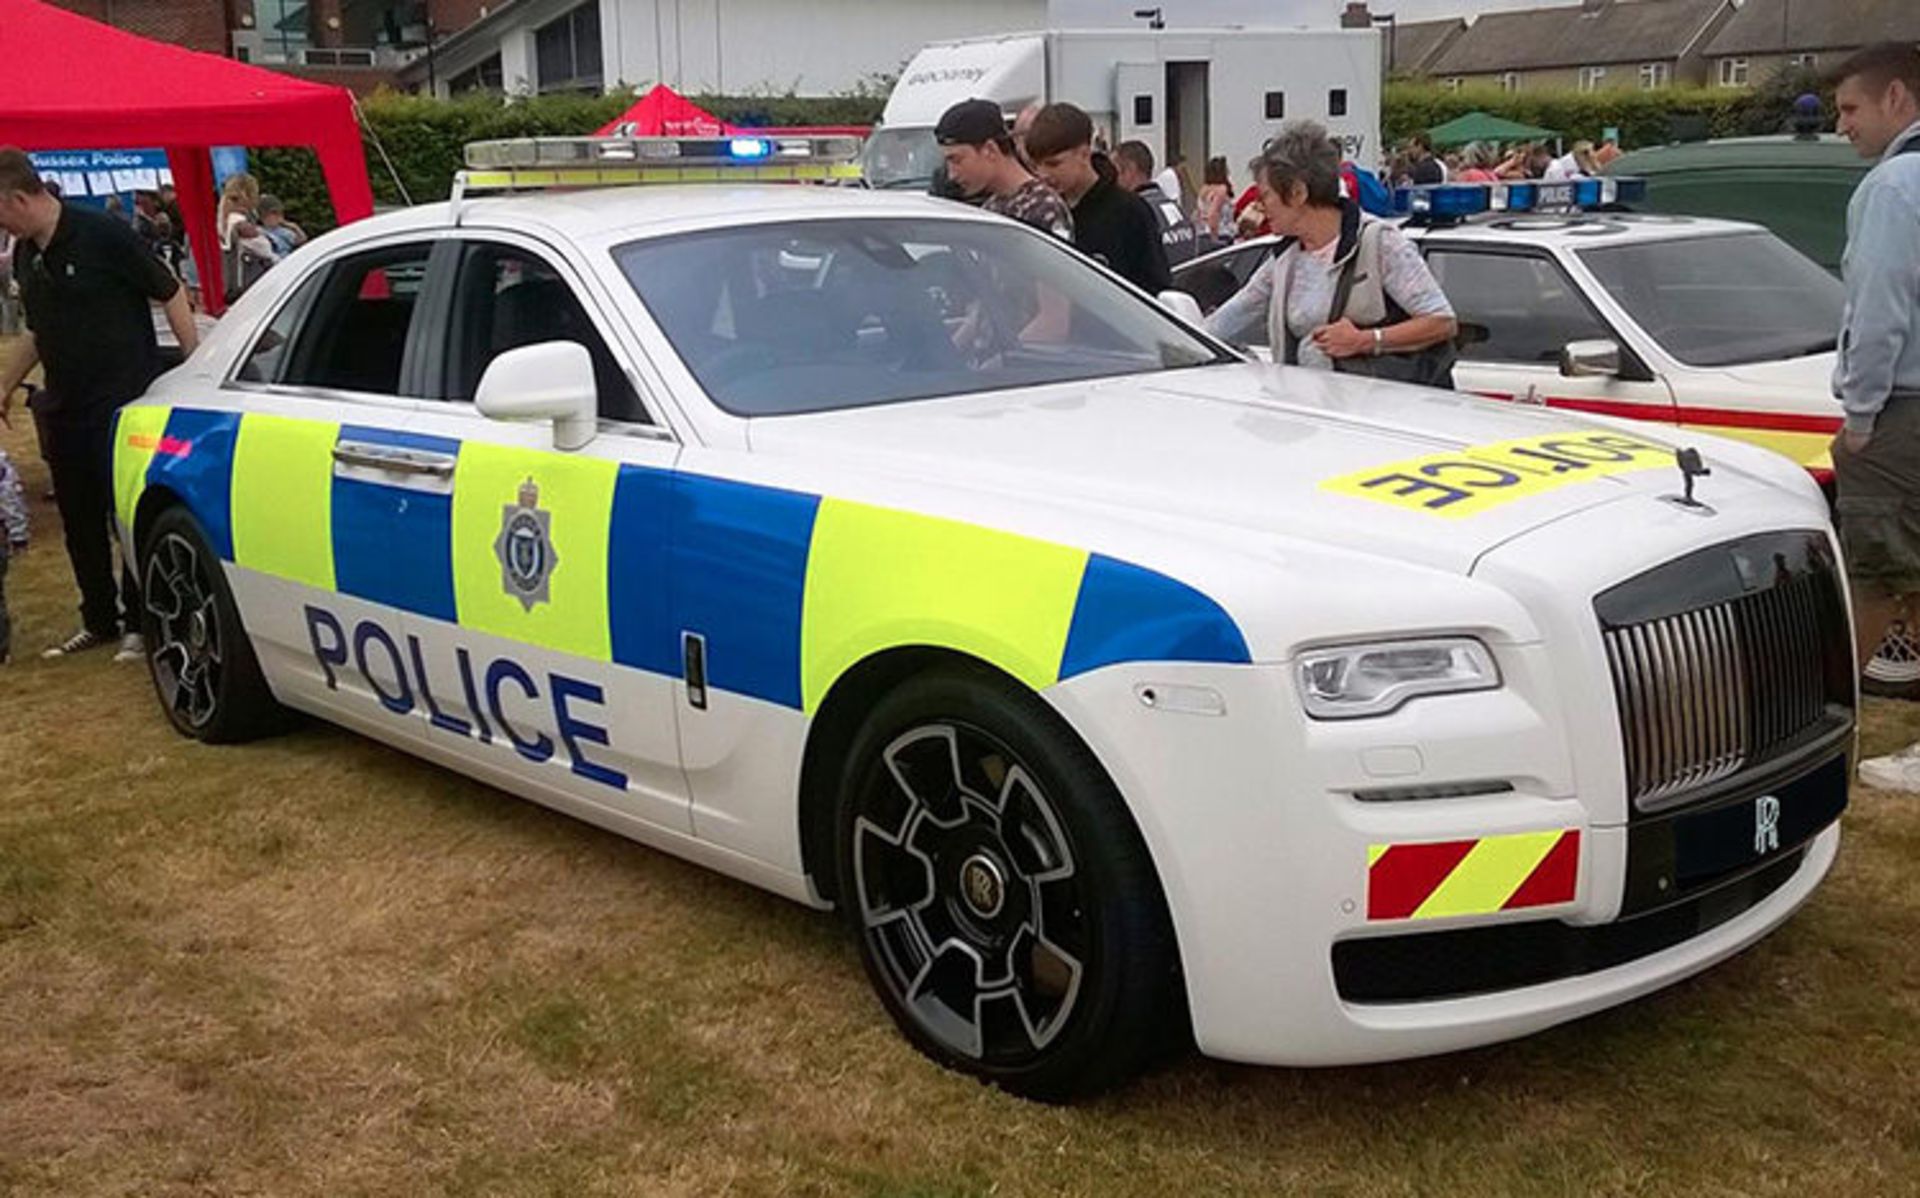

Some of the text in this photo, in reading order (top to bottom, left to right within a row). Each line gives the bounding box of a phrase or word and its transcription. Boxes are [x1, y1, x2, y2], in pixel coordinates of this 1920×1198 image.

[27, 152, 144, 168] Sussex Police
[304, 604, 628, 791] POLICE
